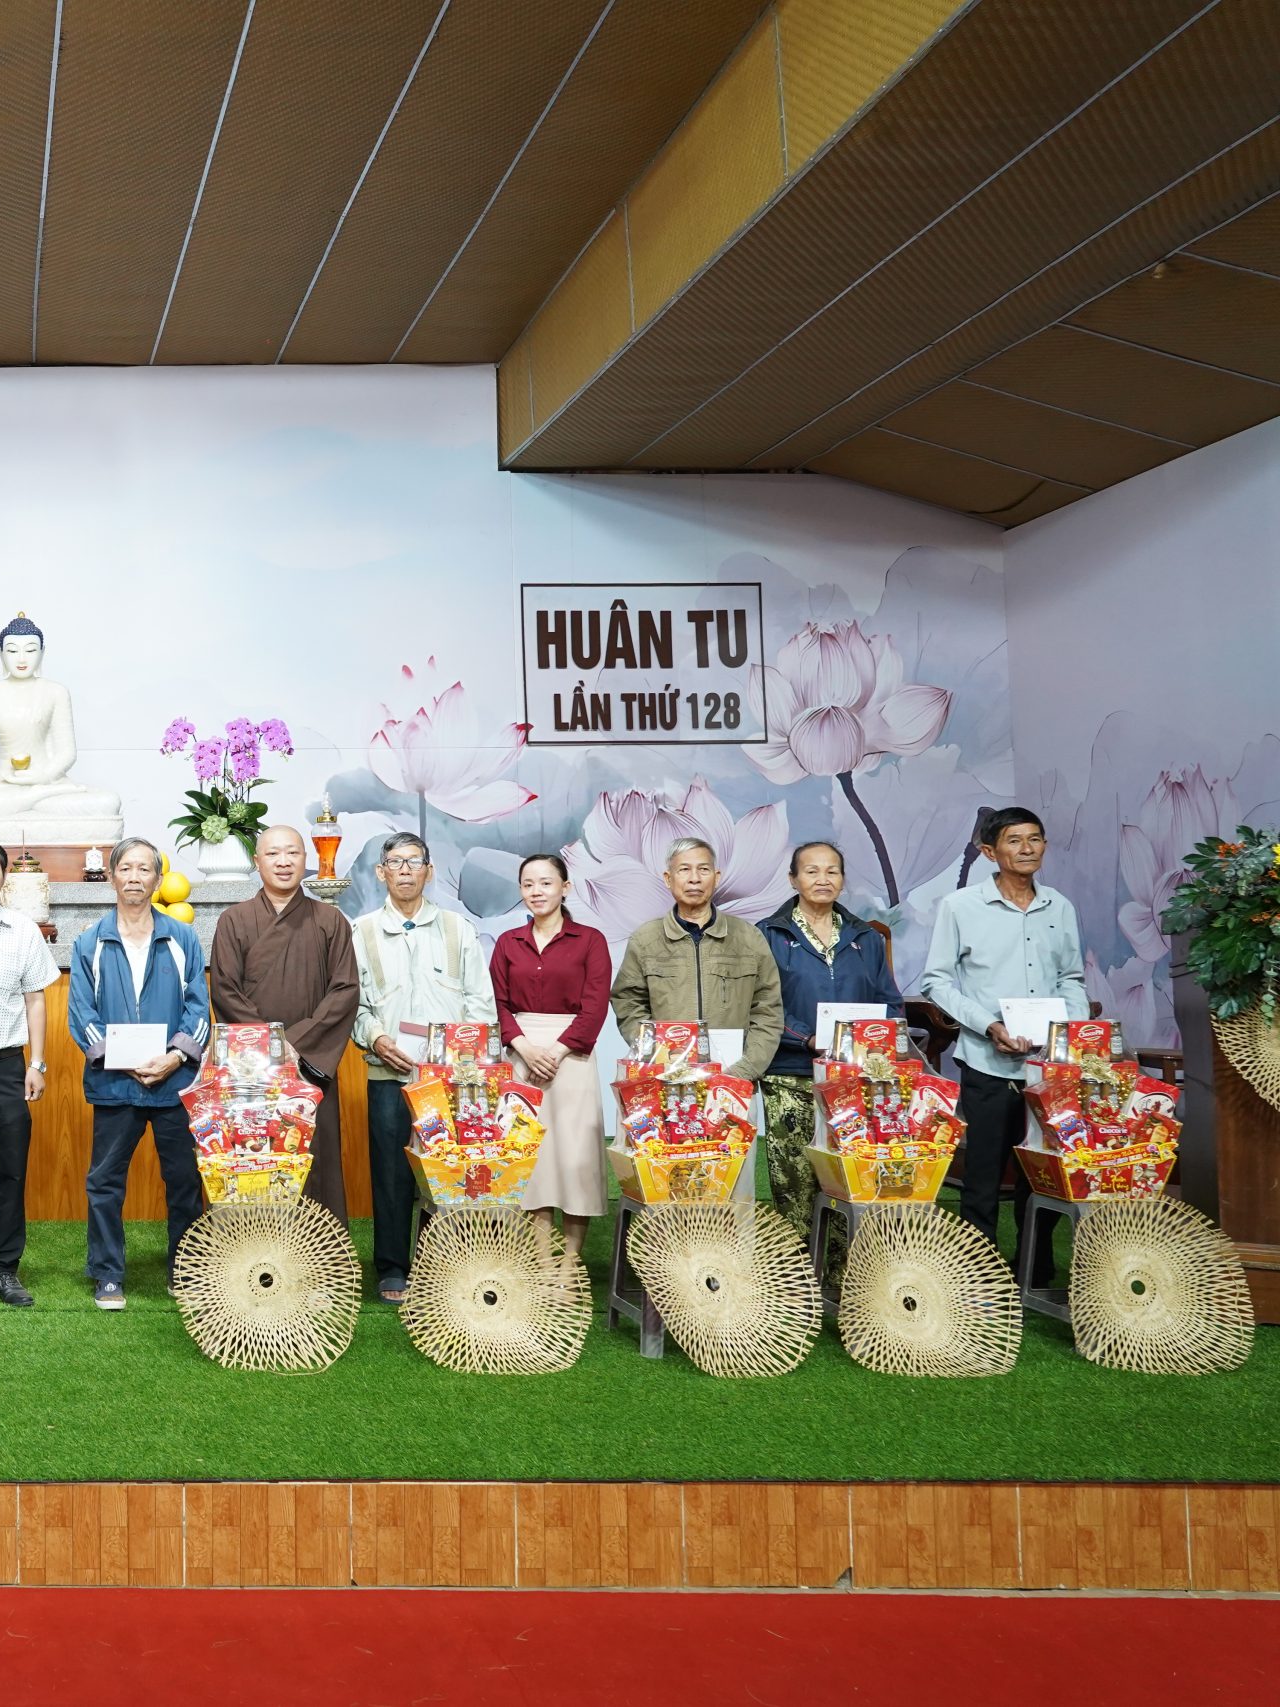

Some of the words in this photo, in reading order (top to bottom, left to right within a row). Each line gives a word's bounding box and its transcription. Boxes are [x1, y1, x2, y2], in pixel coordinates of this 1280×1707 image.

[536, 599, 673, 669] HUÂN
[687, 609, 748, 668] TU
[553, 680, 612, 731] LẦN
[620, 684, 681, 731] THỨ
[686, 692, 741, 730] 128
